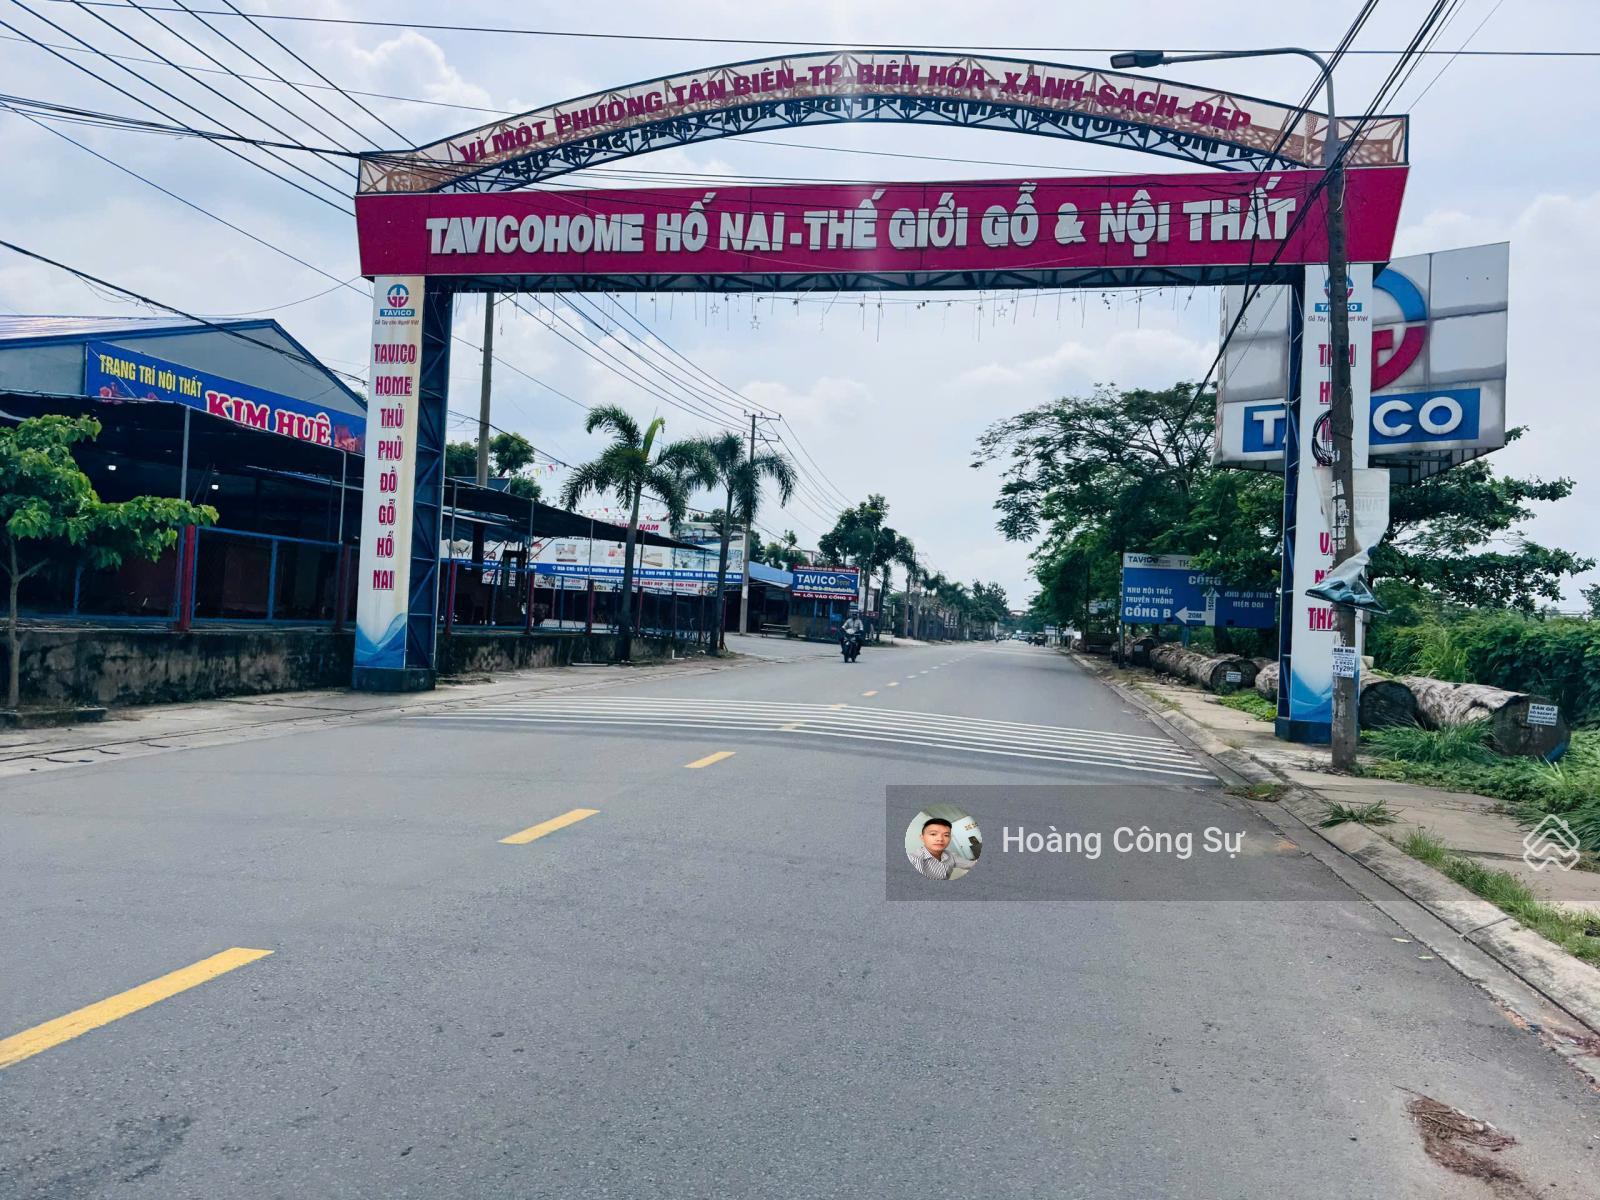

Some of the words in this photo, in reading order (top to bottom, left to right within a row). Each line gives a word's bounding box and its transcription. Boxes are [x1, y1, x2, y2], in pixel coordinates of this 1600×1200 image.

[672, 79, 726, 107] TÂN
[857, 59, 919, 85] BIÊN
[426, 214, 644, 254] TAVICOHOME
[656, 192, 716, 251] HỐ
[889, 192, 969, 250] GIỚI
[981, 181, 1039, 247] GỖ
[1054, 203, 1086, 245] &
[1099, 189, 1170, 257] NỘI
[1183, 176, 1296, 241] THẤT
[374, 344, 417, 364] TAVICO
[100, 355, 136, 381] TRANG
[139, 365, 156, 386] TRÍ
[158, 370, 176, 394] NỘI
[178, 375, 203, 398] THẤT
[376, 376, 412, 396] HOME
[206, 390, 270, 430] KIM
[381, 403, 404, 428] THỦ
[378, 435, 404, 460] PHỦ
[380, 466, 398, 493] ĐỒ
[378, 498, 397, 525] GỖ
[377, 530, 395, 558] HỐ
[373, 570, 395, 591] NAI
[797, 574, 836, 585] TAVICO
[1163, 608, 1172, 618] B
